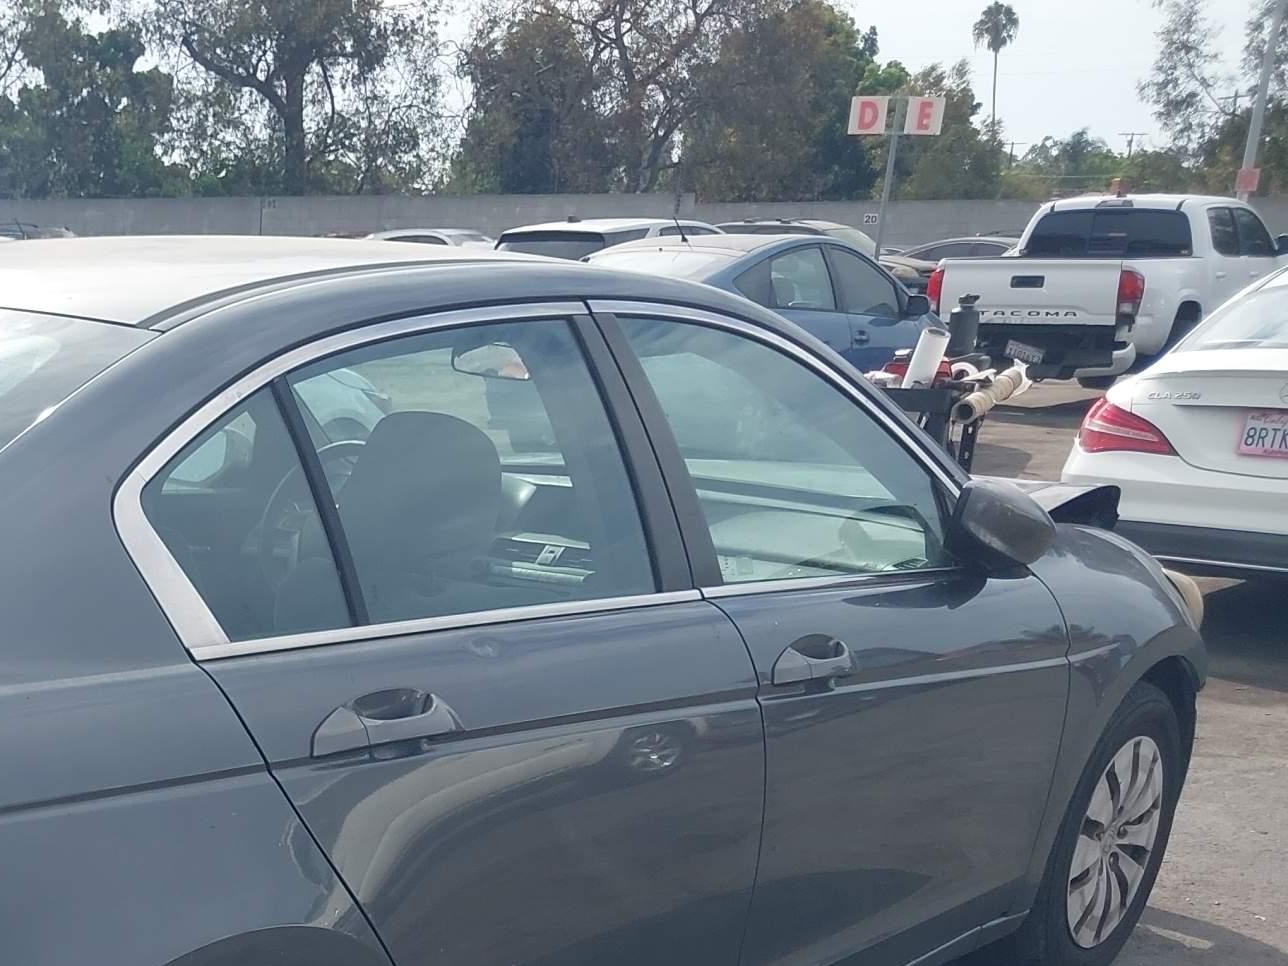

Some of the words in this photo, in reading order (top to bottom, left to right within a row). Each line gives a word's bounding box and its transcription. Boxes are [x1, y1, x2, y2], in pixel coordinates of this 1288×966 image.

[857, 101, 879, 130] D
[916, 101, 934, 131] E
[864, 214, 877, 224] 20
[1146, 391, 1172, 400] CLA
[1174, 391, 1202, 400] 250
[1244, 426, 1288, 449] 8RTK
